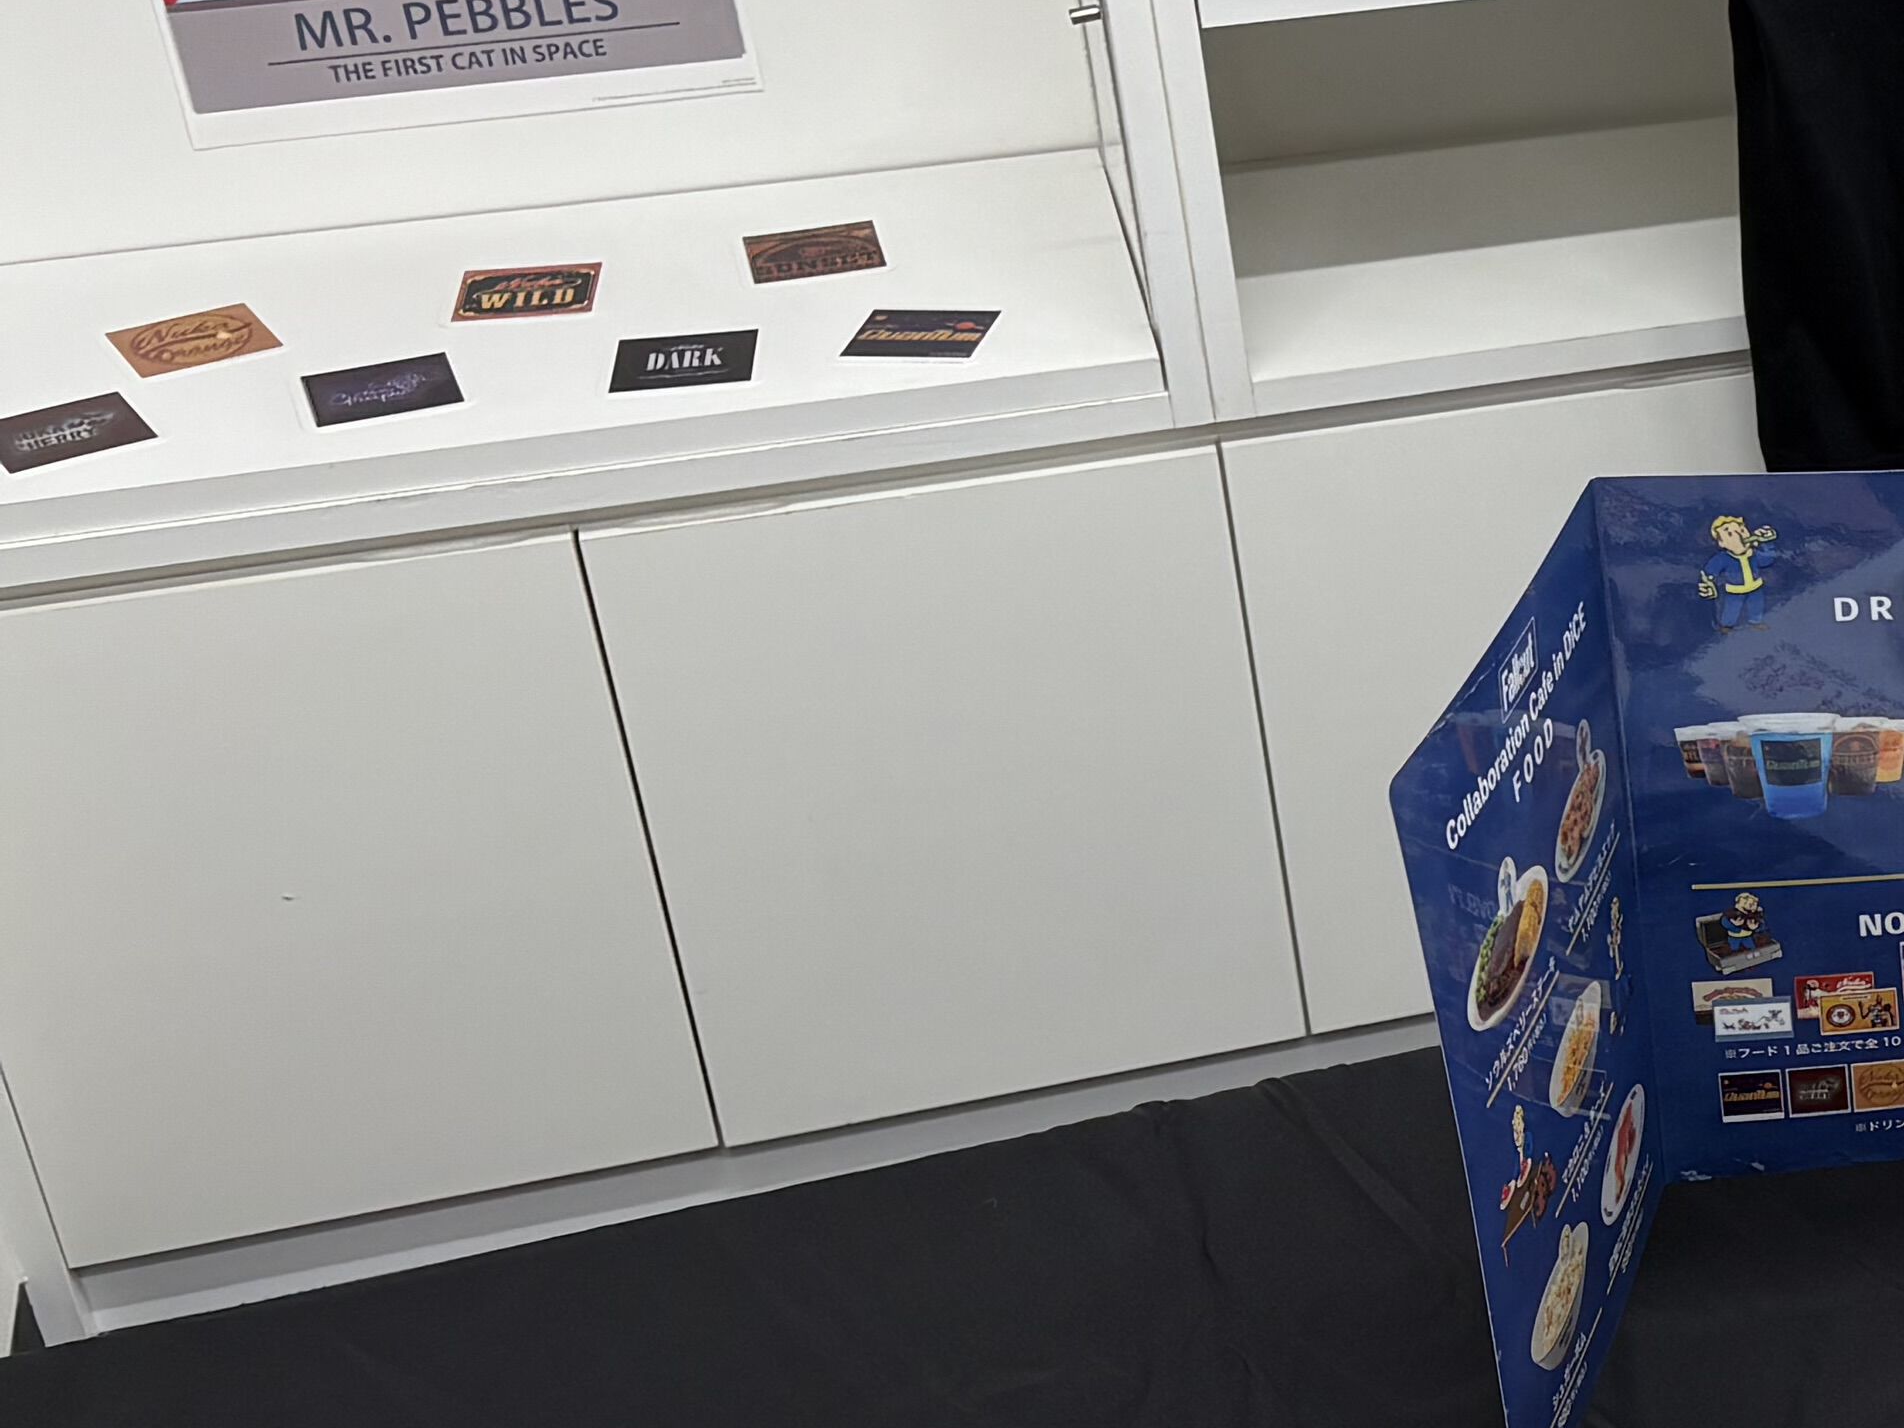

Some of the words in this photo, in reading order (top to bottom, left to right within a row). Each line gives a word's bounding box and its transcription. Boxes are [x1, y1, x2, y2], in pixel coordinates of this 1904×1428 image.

[294, 6, 392, 52] MR.
[327, 63, 376, 84] THE
[382, 54, 445, 79] FIRST
[451, 51, 496, 72] CAT
[502, 46, 528, 66] IN
[534, 38, 608, 62] SPACE
[478, 286, 574, 312] WILD
[646, 346, 725, 372] DARK
[1444, 697, 1530, 864] Collaboration
[1527, 659, 1554, 728] Cafe
[1552, 641, 1564, 686] in
[1511, 709, 1554, 806] FOOD
